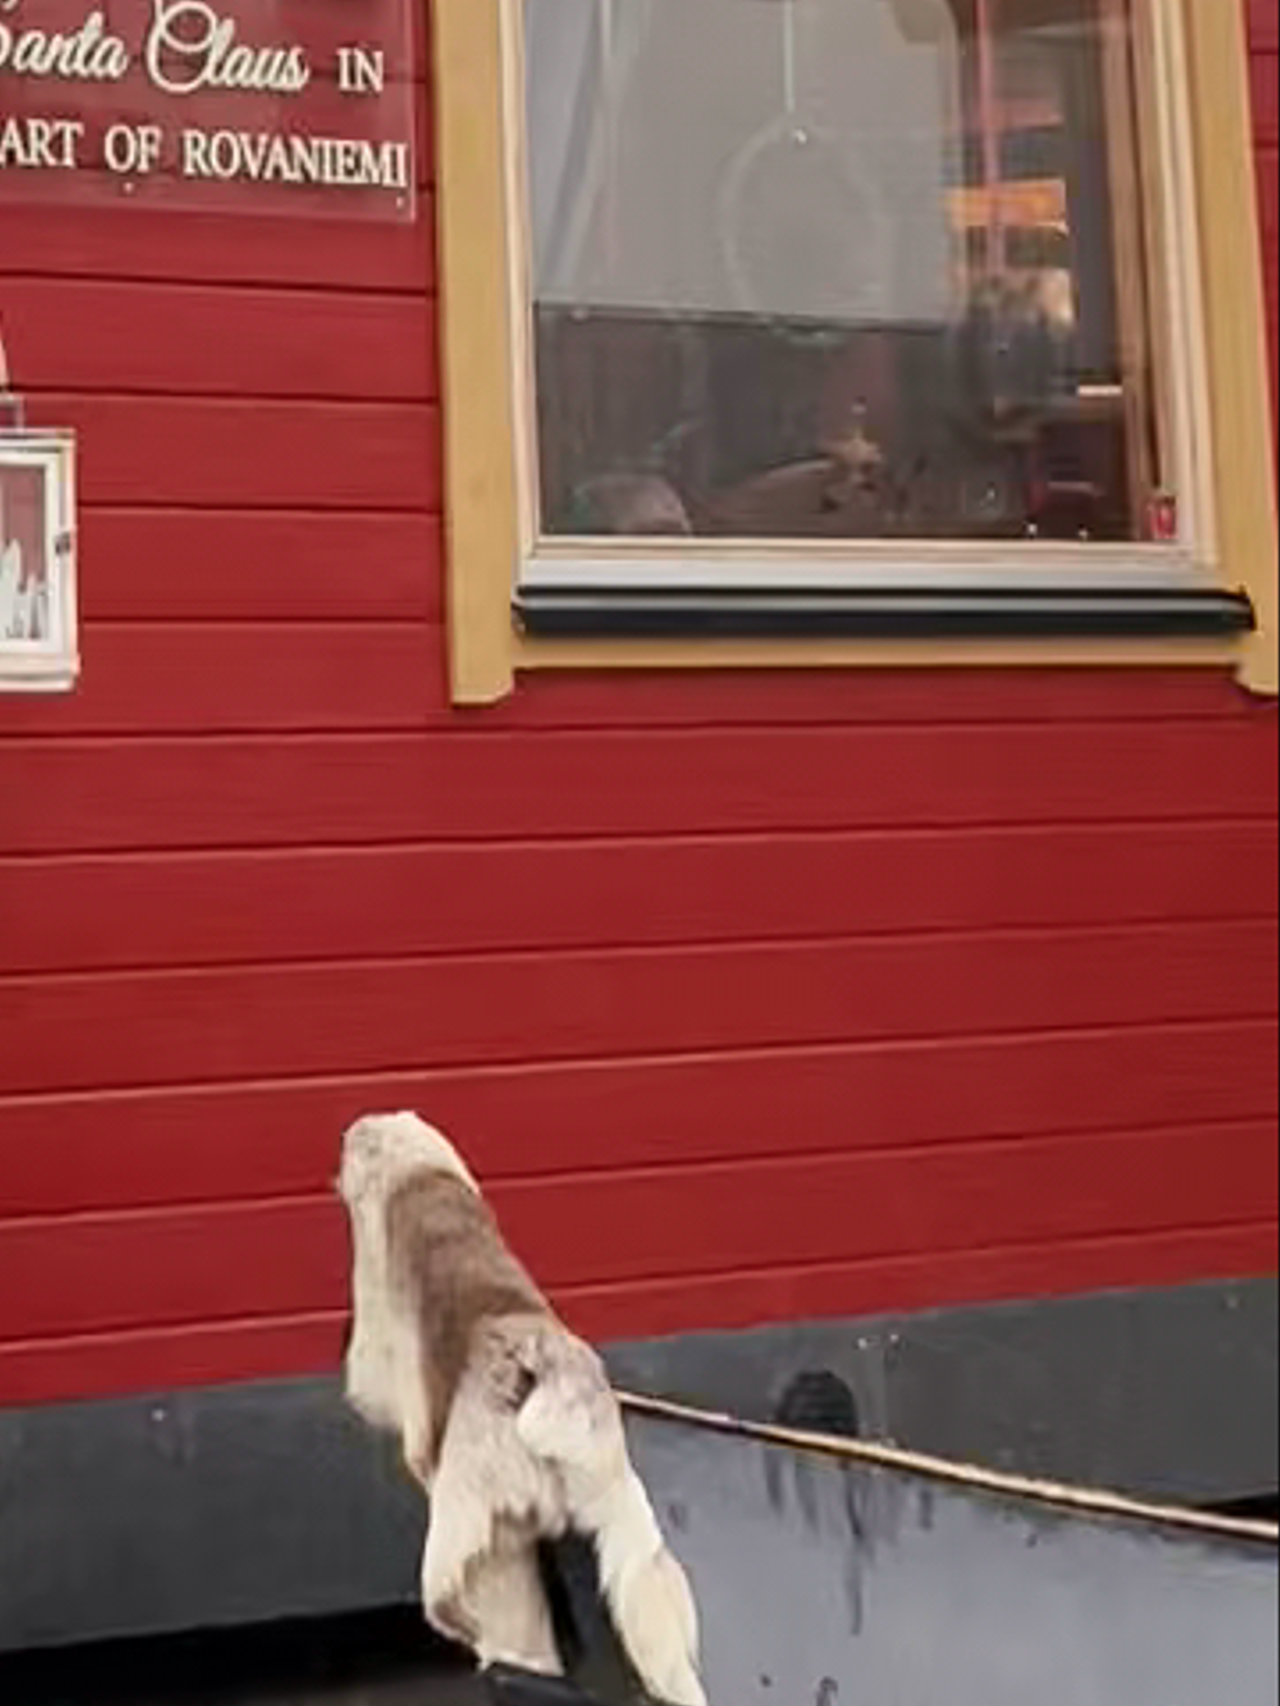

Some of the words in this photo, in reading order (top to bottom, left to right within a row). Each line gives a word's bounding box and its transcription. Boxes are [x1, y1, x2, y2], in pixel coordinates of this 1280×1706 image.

[336, 47, 385, 92] IN
[103, 124, 161, 173] OF
[183, 129, 409, 188] ROVANIEMI
